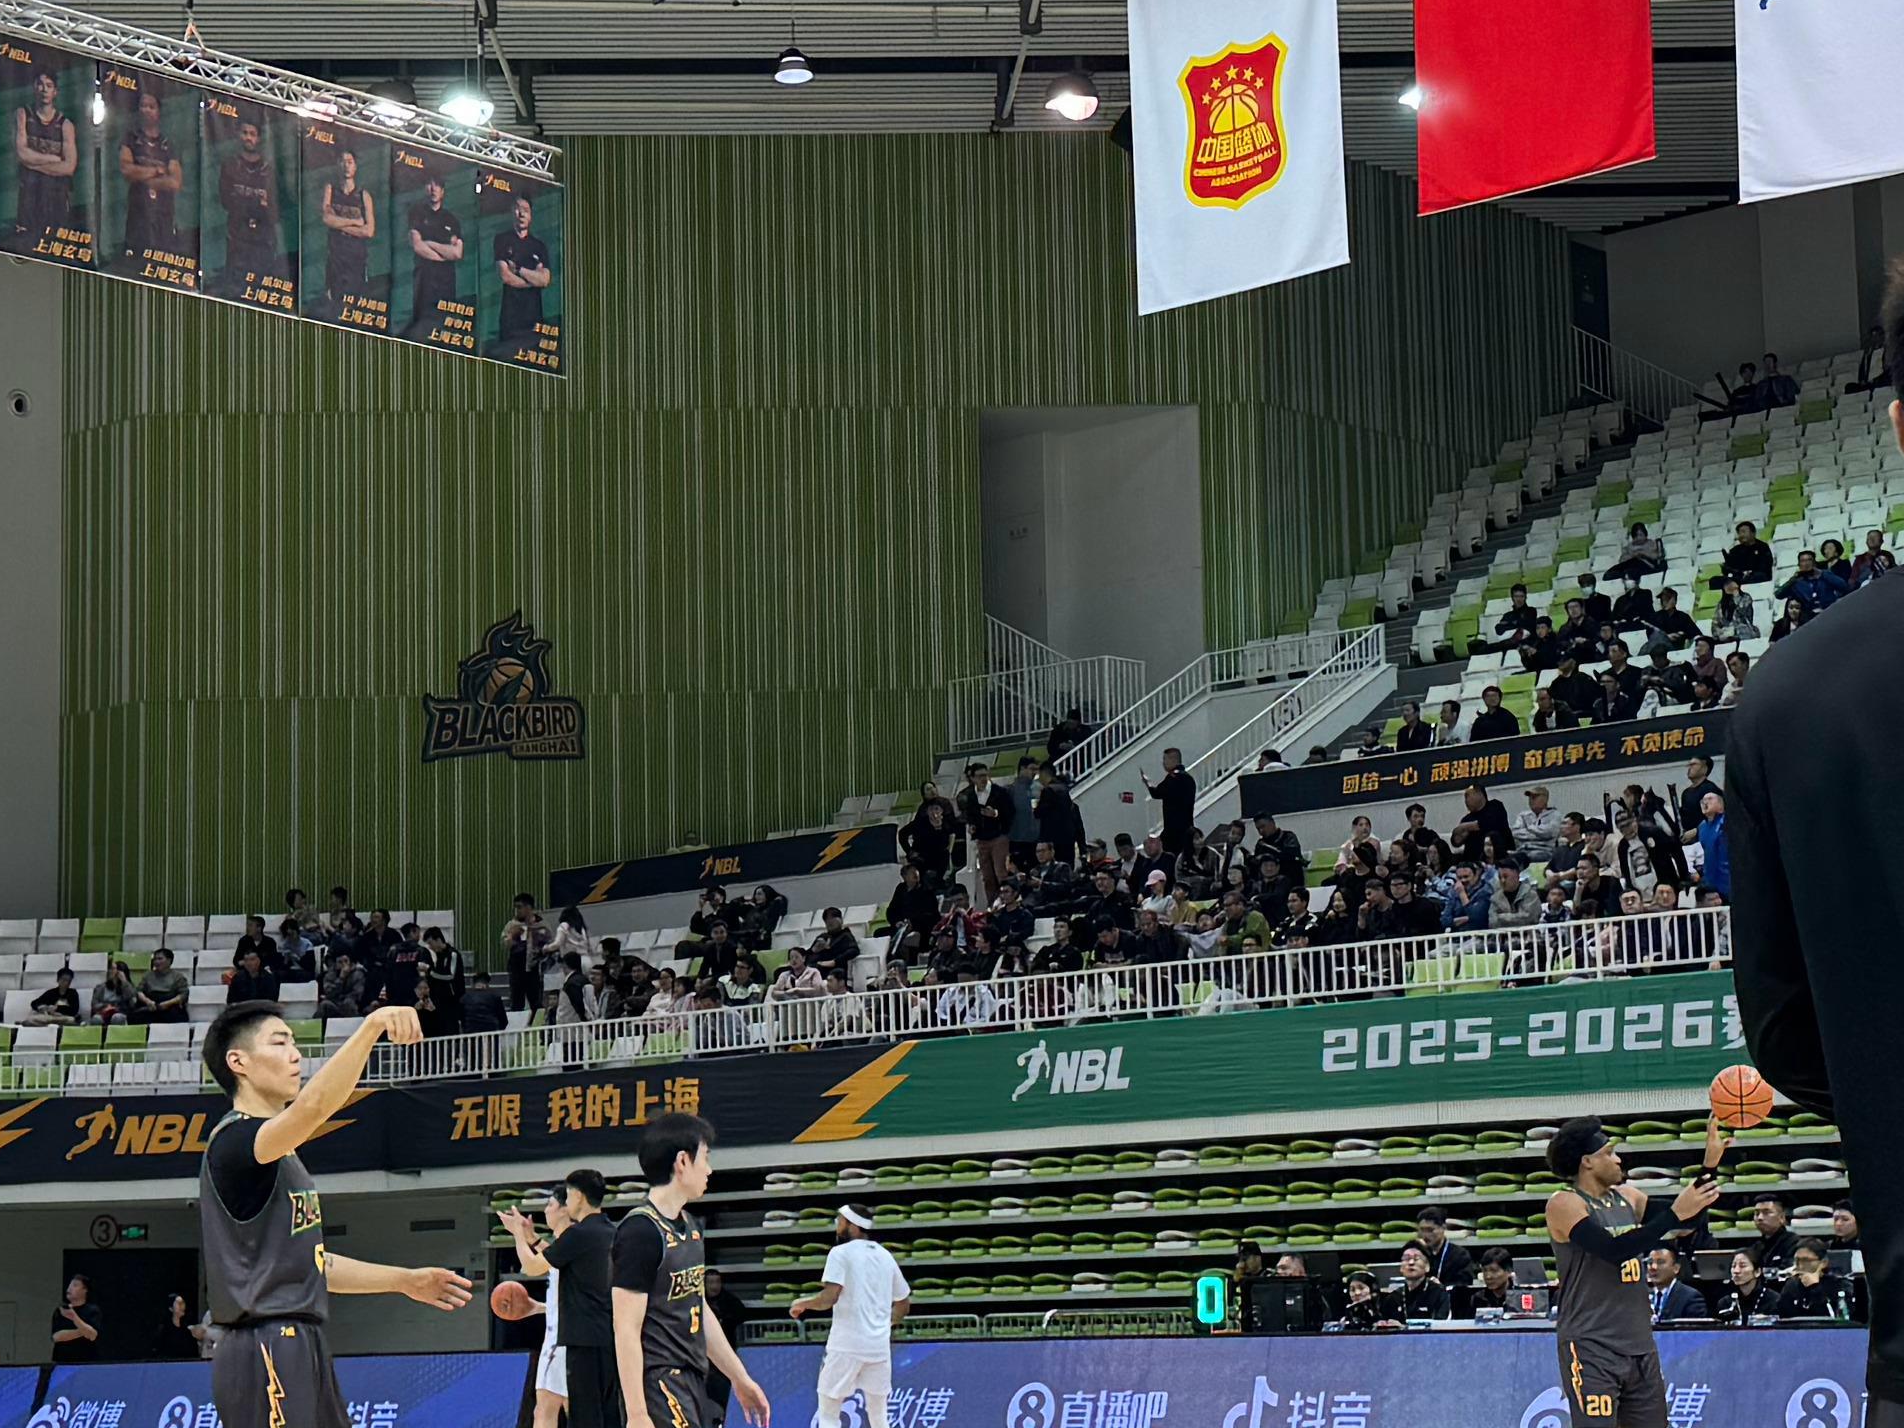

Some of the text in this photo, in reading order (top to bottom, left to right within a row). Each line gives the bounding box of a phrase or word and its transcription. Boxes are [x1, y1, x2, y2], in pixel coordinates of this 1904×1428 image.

[431, 704, 577, 753] BLACKBIRD
[514, 738, 577, 753] SHANGHAI
[1049, 1047, 1131, 1095] NBL
[113, 1112, 208, 1155] NBL
[450, 1093, 521, 1140] 无限
[1620, 1258, 1642, 1284] 20
[1586, 1394, 1613, 1417] 20
